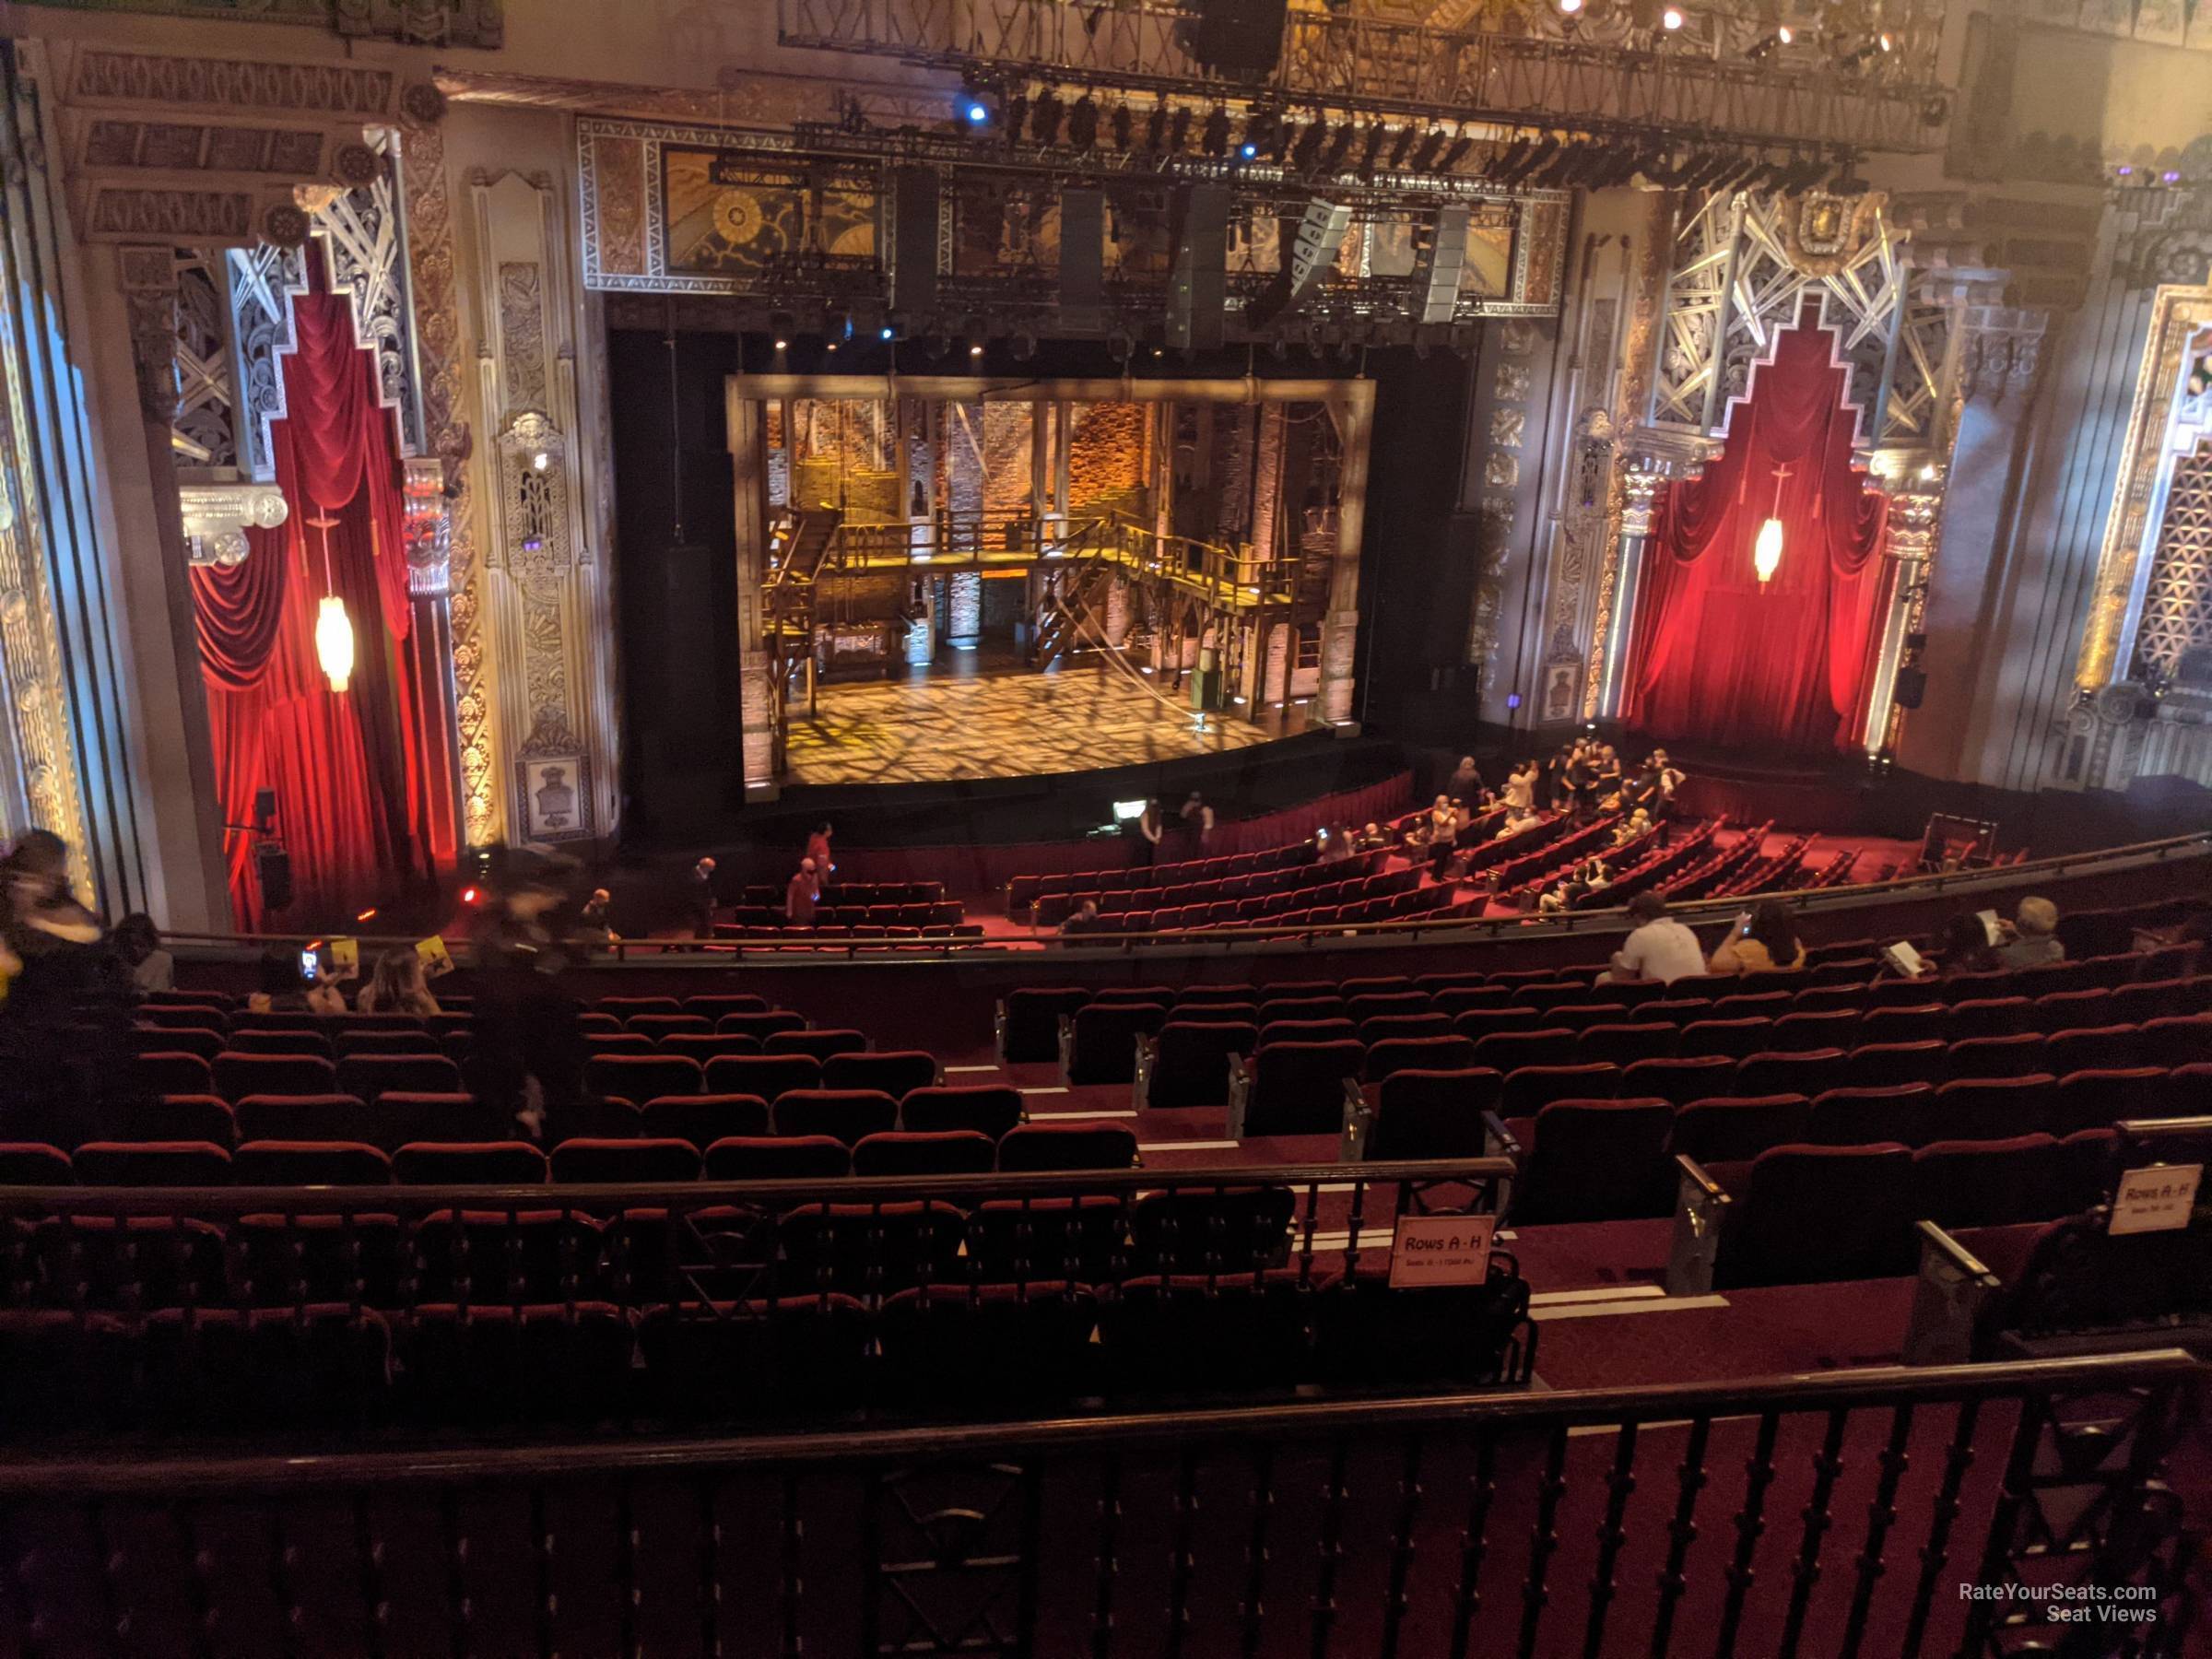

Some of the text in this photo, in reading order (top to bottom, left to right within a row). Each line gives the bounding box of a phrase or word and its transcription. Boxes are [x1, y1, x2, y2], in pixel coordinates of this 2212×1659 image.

[2161, 1184, 2171, 1196] A
[2179, 1183, 2189, 1195] H
[1449, 1236, 1460, 1250] A
[1471, 1235, 1481, 1249] H
